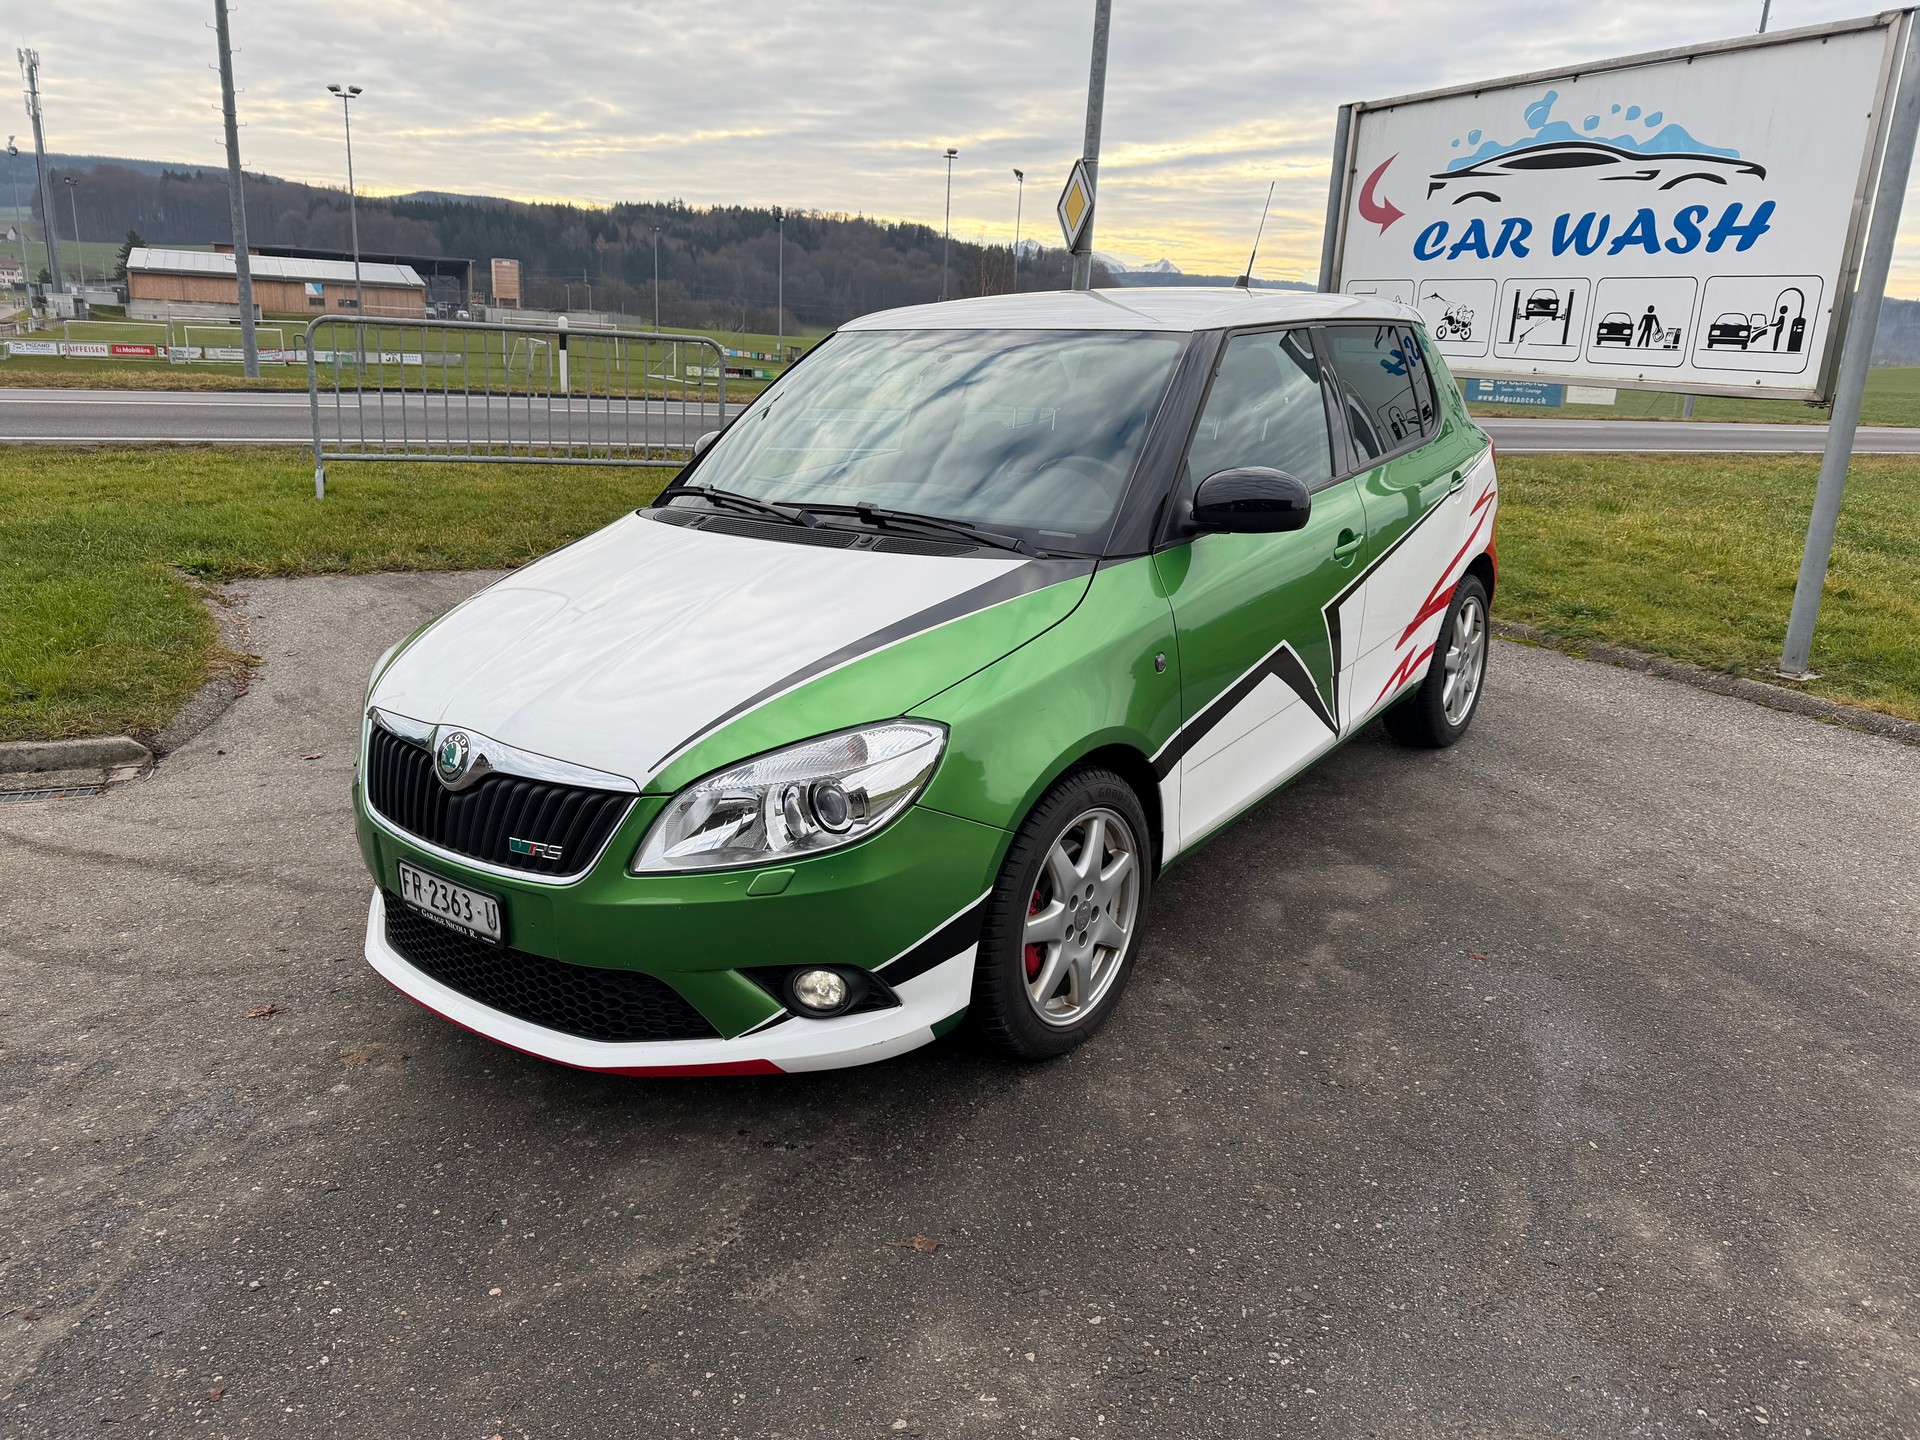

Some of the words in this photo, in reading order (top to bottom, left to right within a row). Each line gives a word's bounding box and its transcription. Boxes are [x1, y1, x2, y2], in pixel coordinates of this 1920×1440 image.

[1413, 217, 1533, 261] CAR
[1552, 200, 1776, 256] WASH
[62, 345, 105, 353] RAIFFEISEN
[1477, 394, 1547, 405] www.bdgerance.ch
